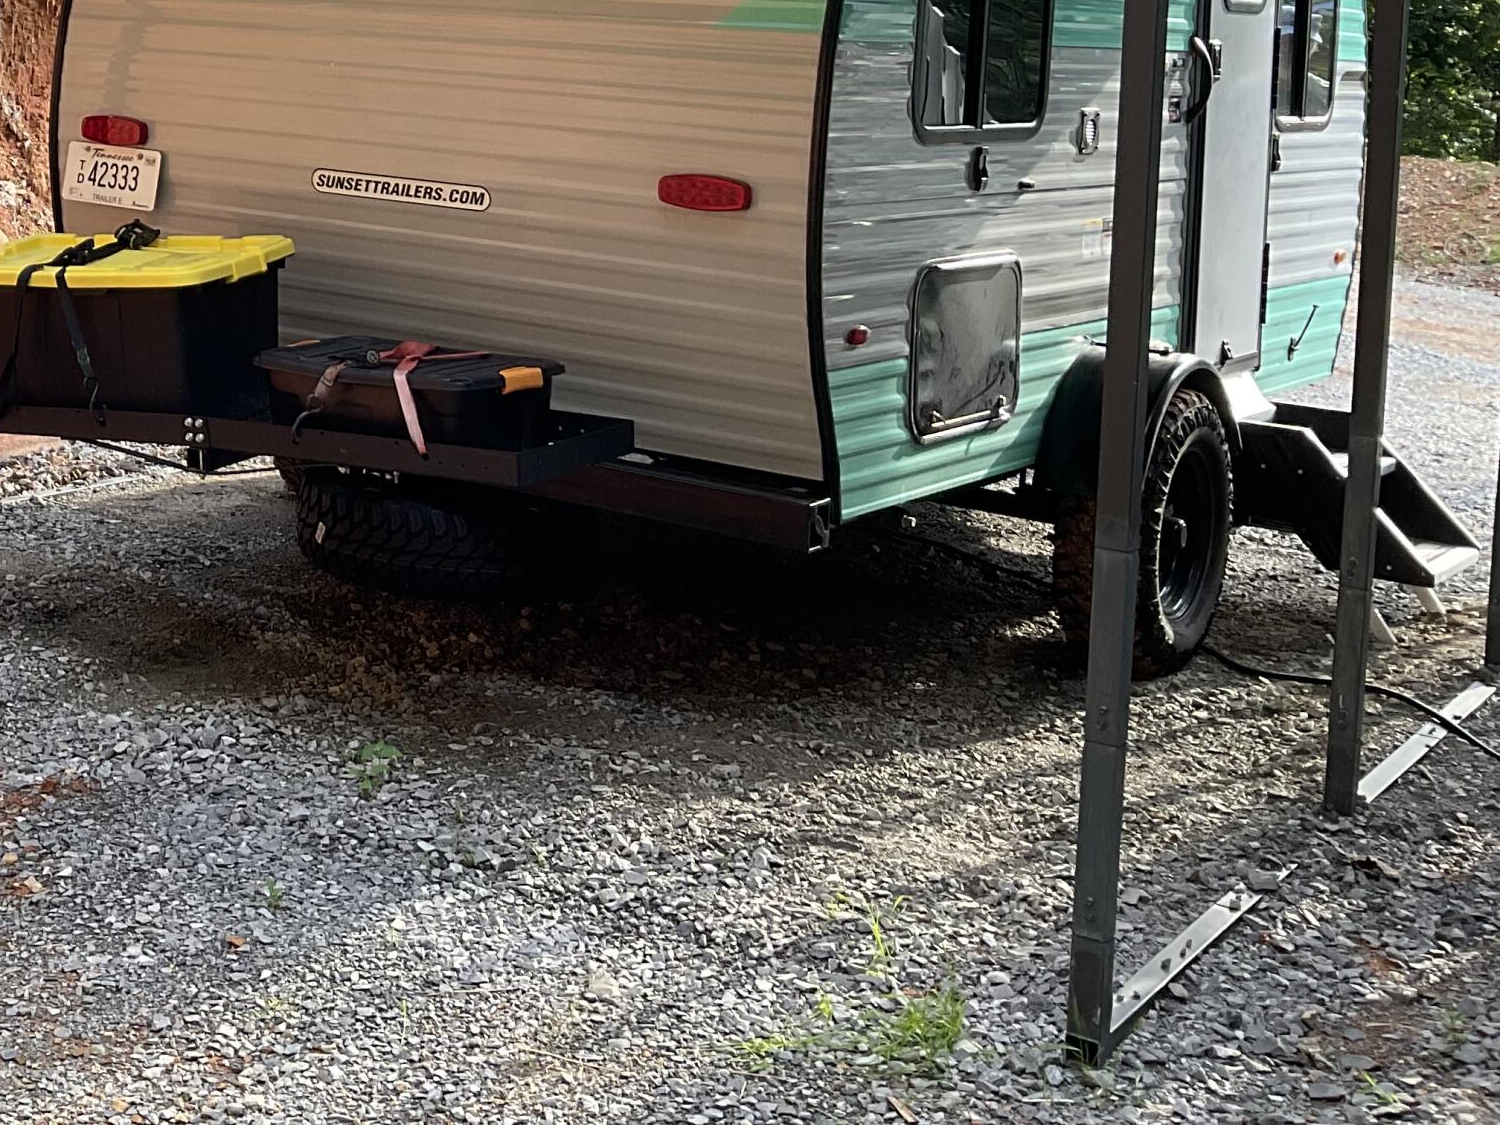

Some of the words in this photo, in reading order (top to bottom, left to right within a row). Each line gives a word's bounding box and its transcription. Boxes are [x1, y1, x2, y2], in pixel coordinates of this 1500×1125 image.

[88, 160, 140, 192] 42333
[316, 173, 486, 206] SUNSETTRAILERS.COM
[92, 193, 117, 204] TRAILER
